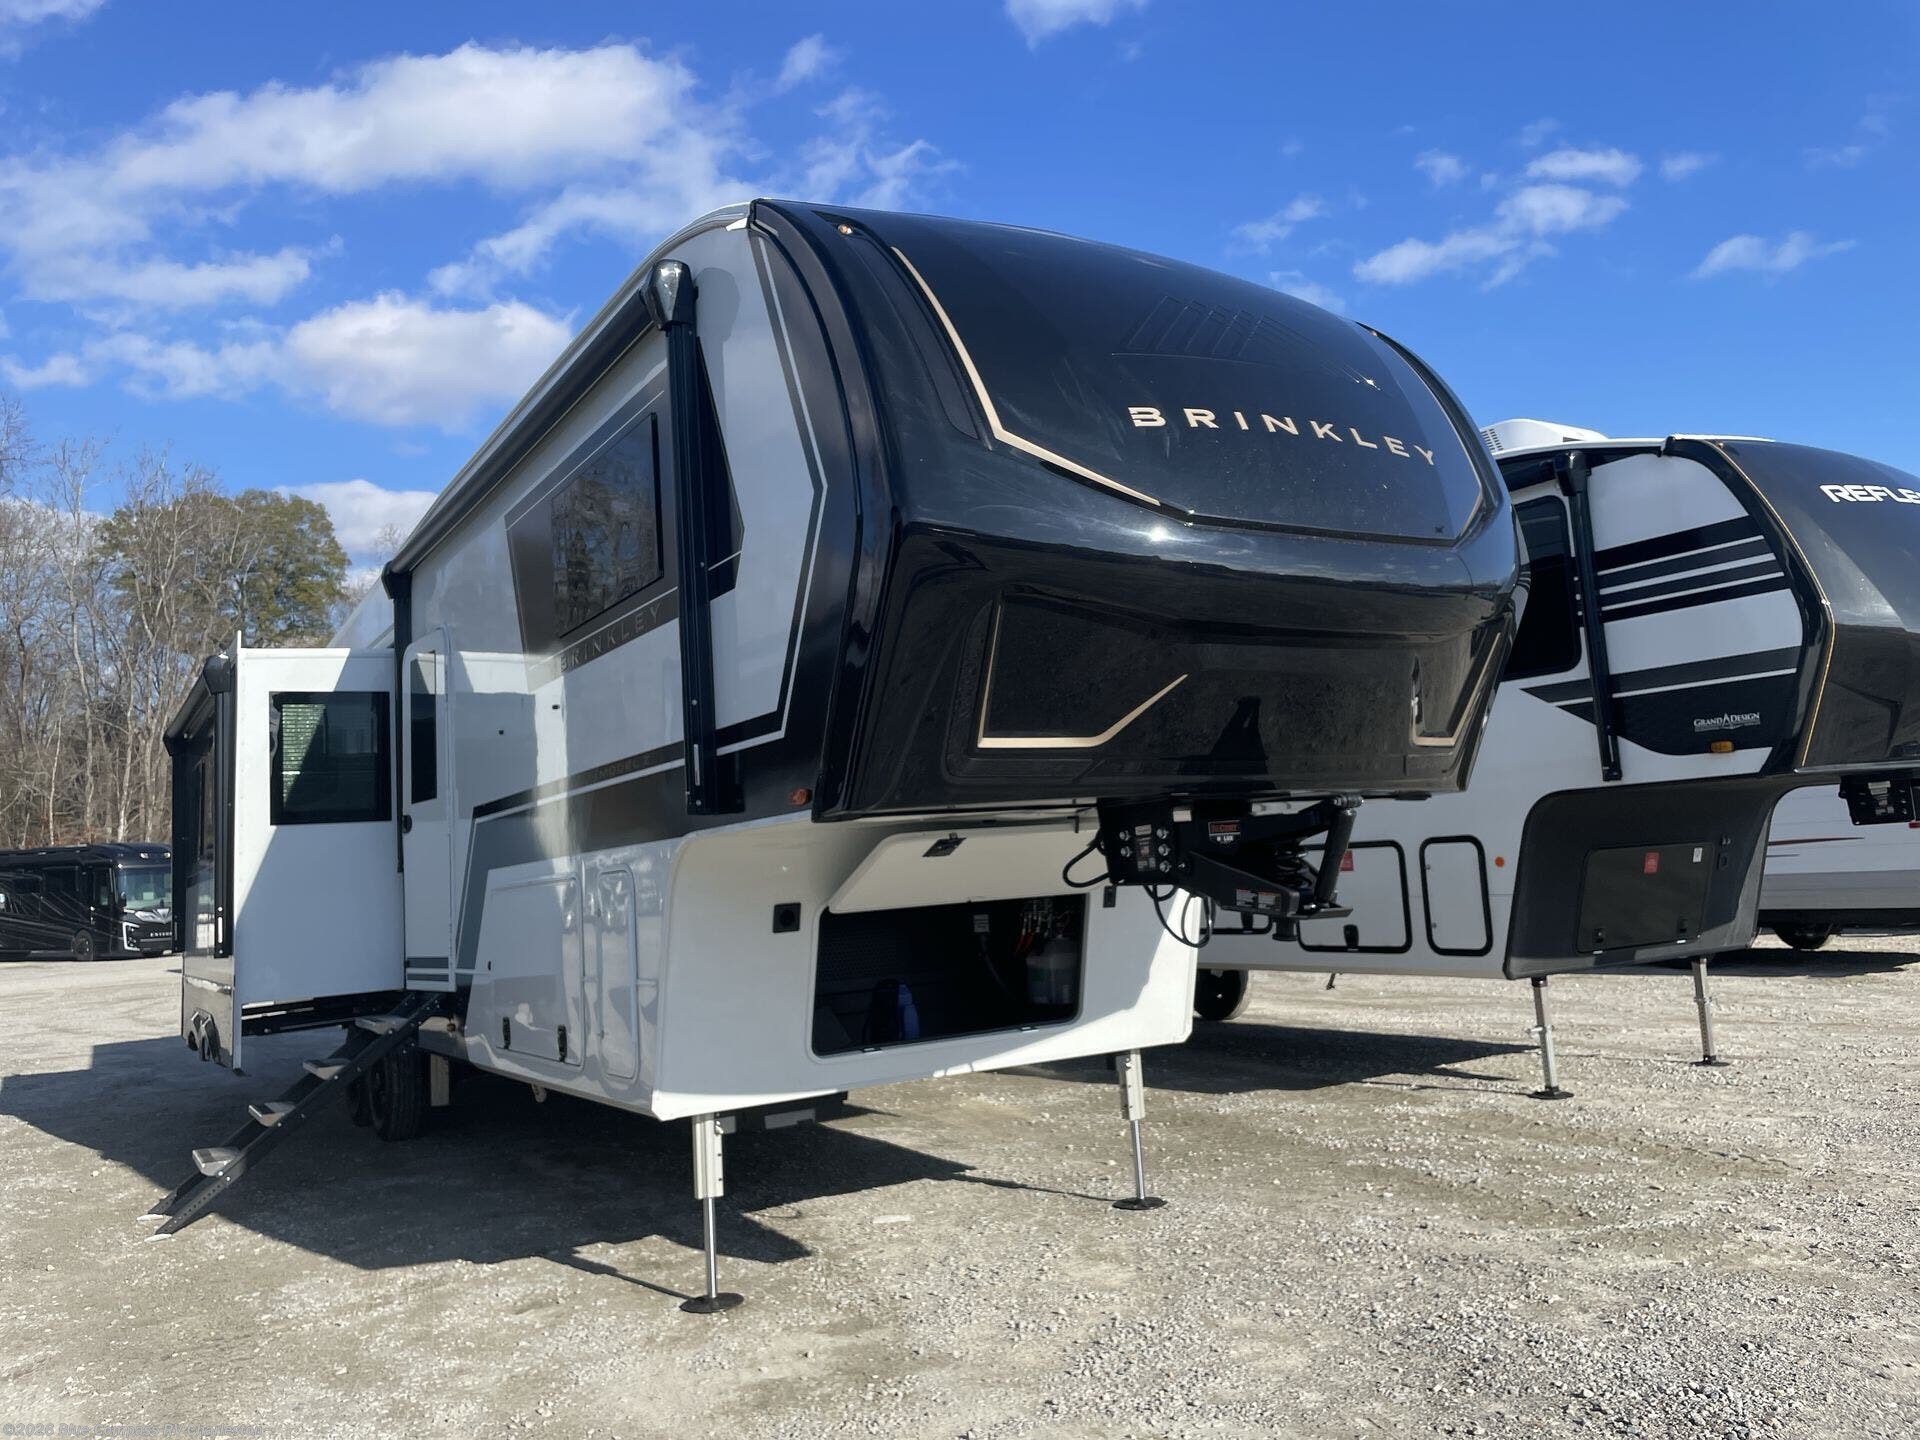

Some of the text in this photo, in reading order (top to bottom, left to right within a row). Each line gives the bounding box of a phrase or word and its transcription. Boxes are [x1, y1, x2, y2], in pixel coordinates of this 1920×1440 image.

[1127, 406, 1435, 466] BRINKLEY
[1820, 484, 1920, 504] REFLE
[560, 602, 661, 672] BRINKLEY
